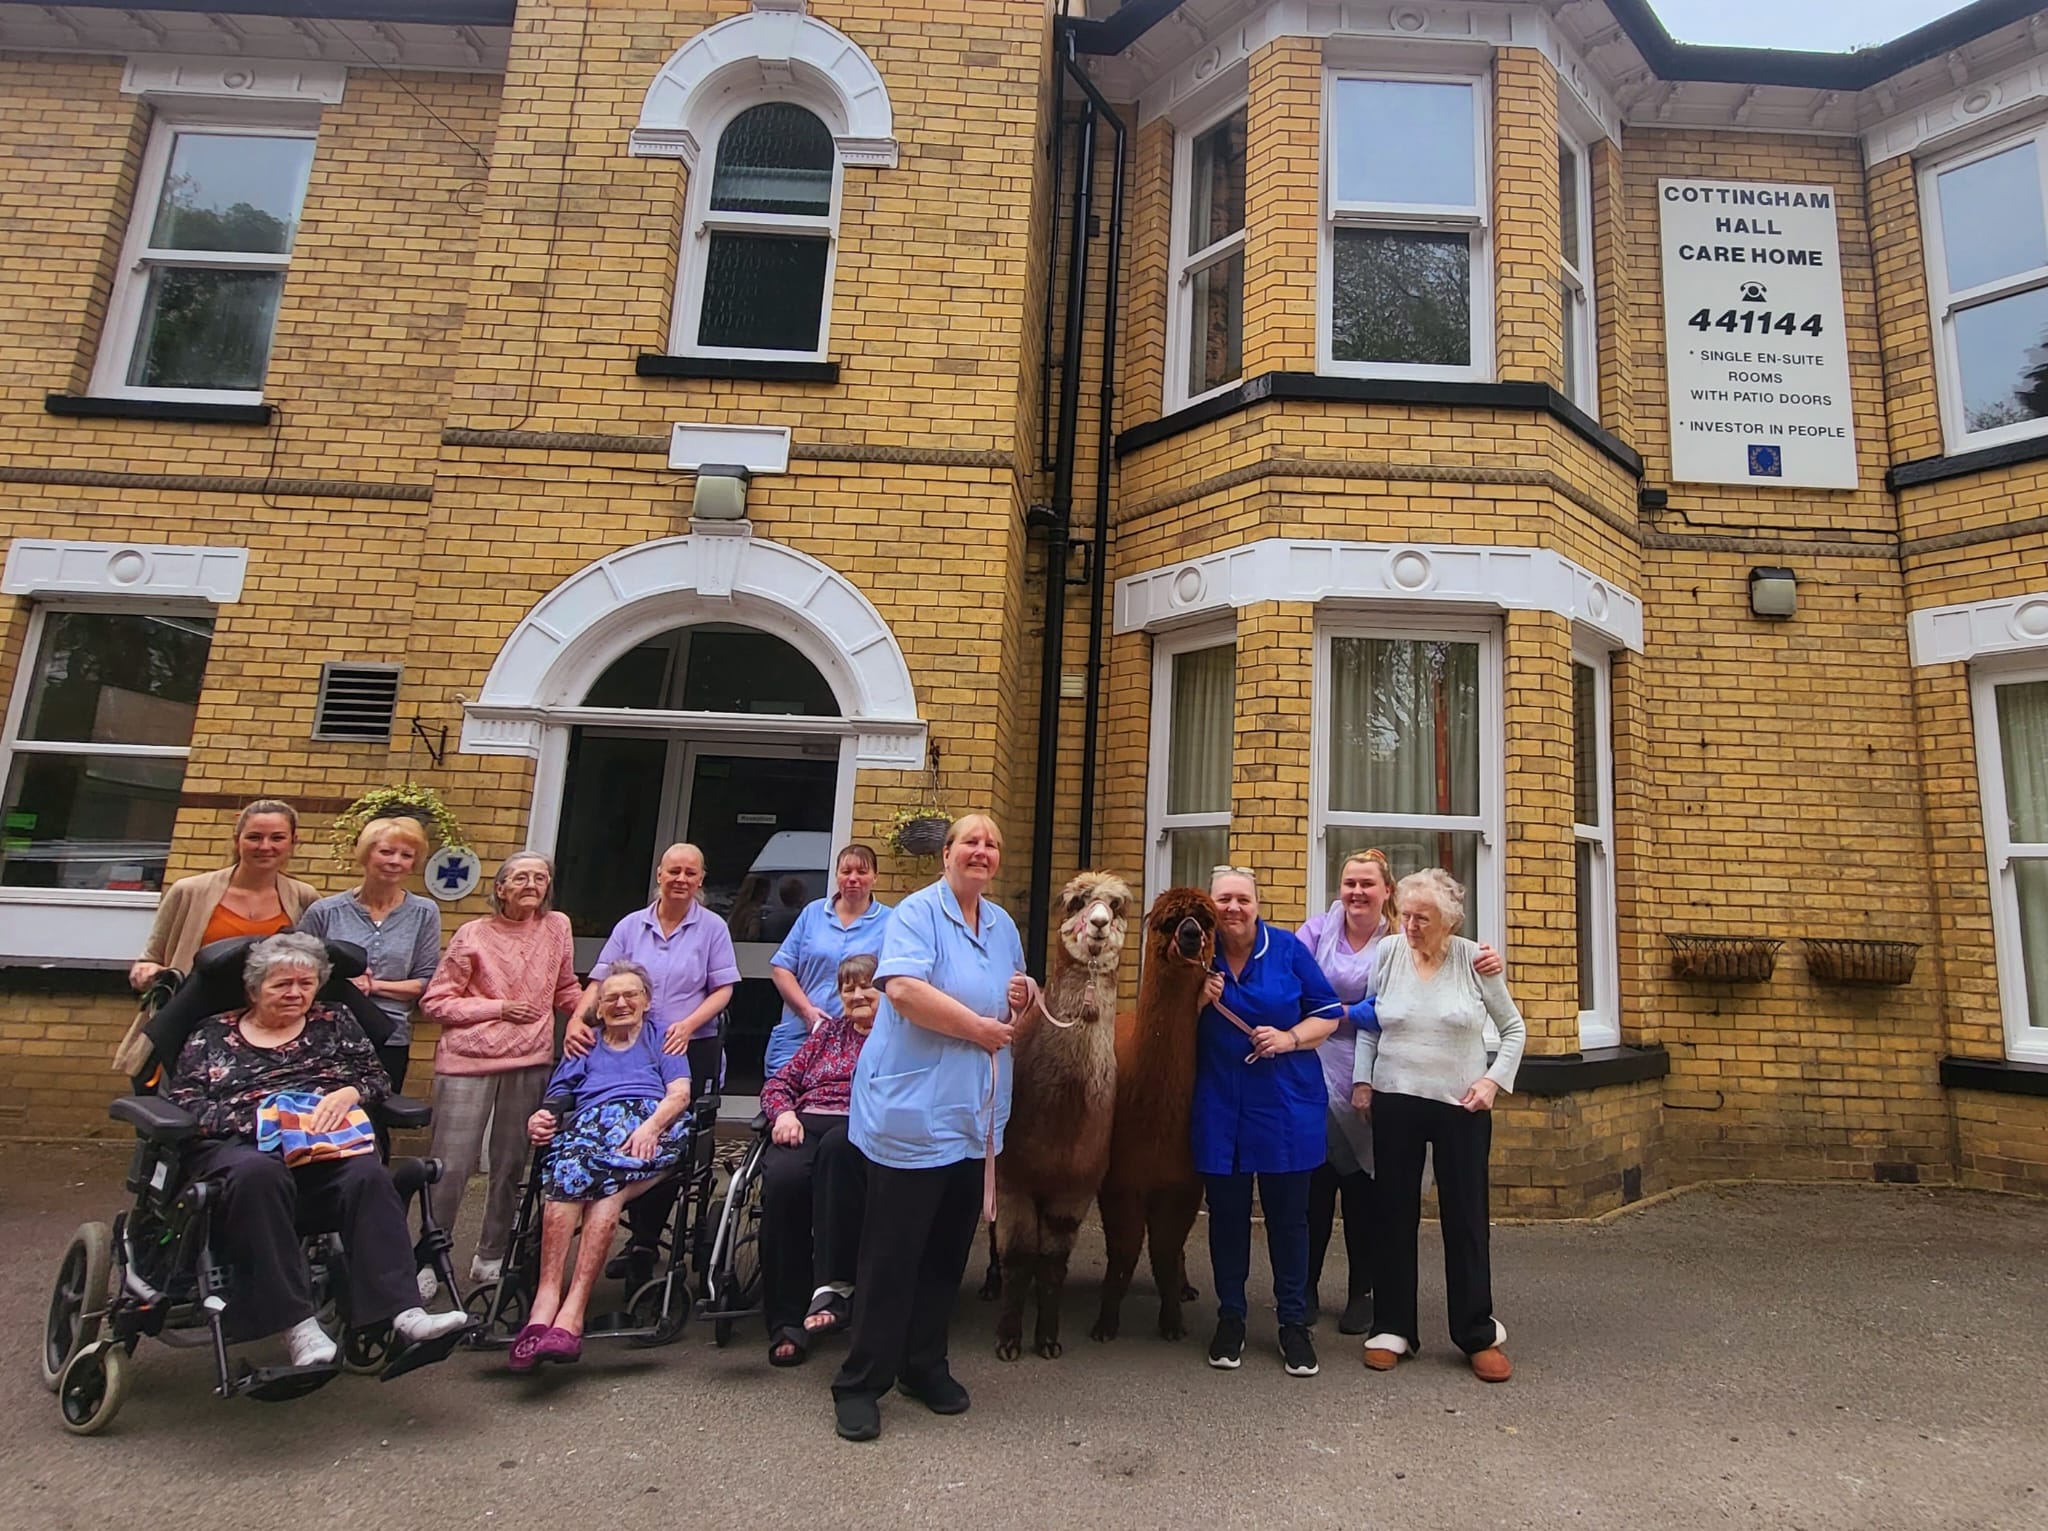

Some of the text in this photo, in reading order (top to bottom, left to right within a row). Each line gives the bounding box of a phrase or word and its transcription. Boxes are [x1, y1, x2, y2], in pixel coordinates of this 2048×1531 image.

[1663, 186, 1831, 209] COTTINGHAM
[1715, 216, 1782, 235] HALL
[1678, 244, 1824, 267] CARE HOME
[1687, 308, 1824, 337] 441144
[1700, 350, 1825, 366] SINGLE EN-SUITE
[1728, 371, 1783, 384] ROOMS
[1690, 389, 1832, 406] WITH PATIO DOORS
[1690, 421, 1846, 438] INVESTOR IN PEOPLE
